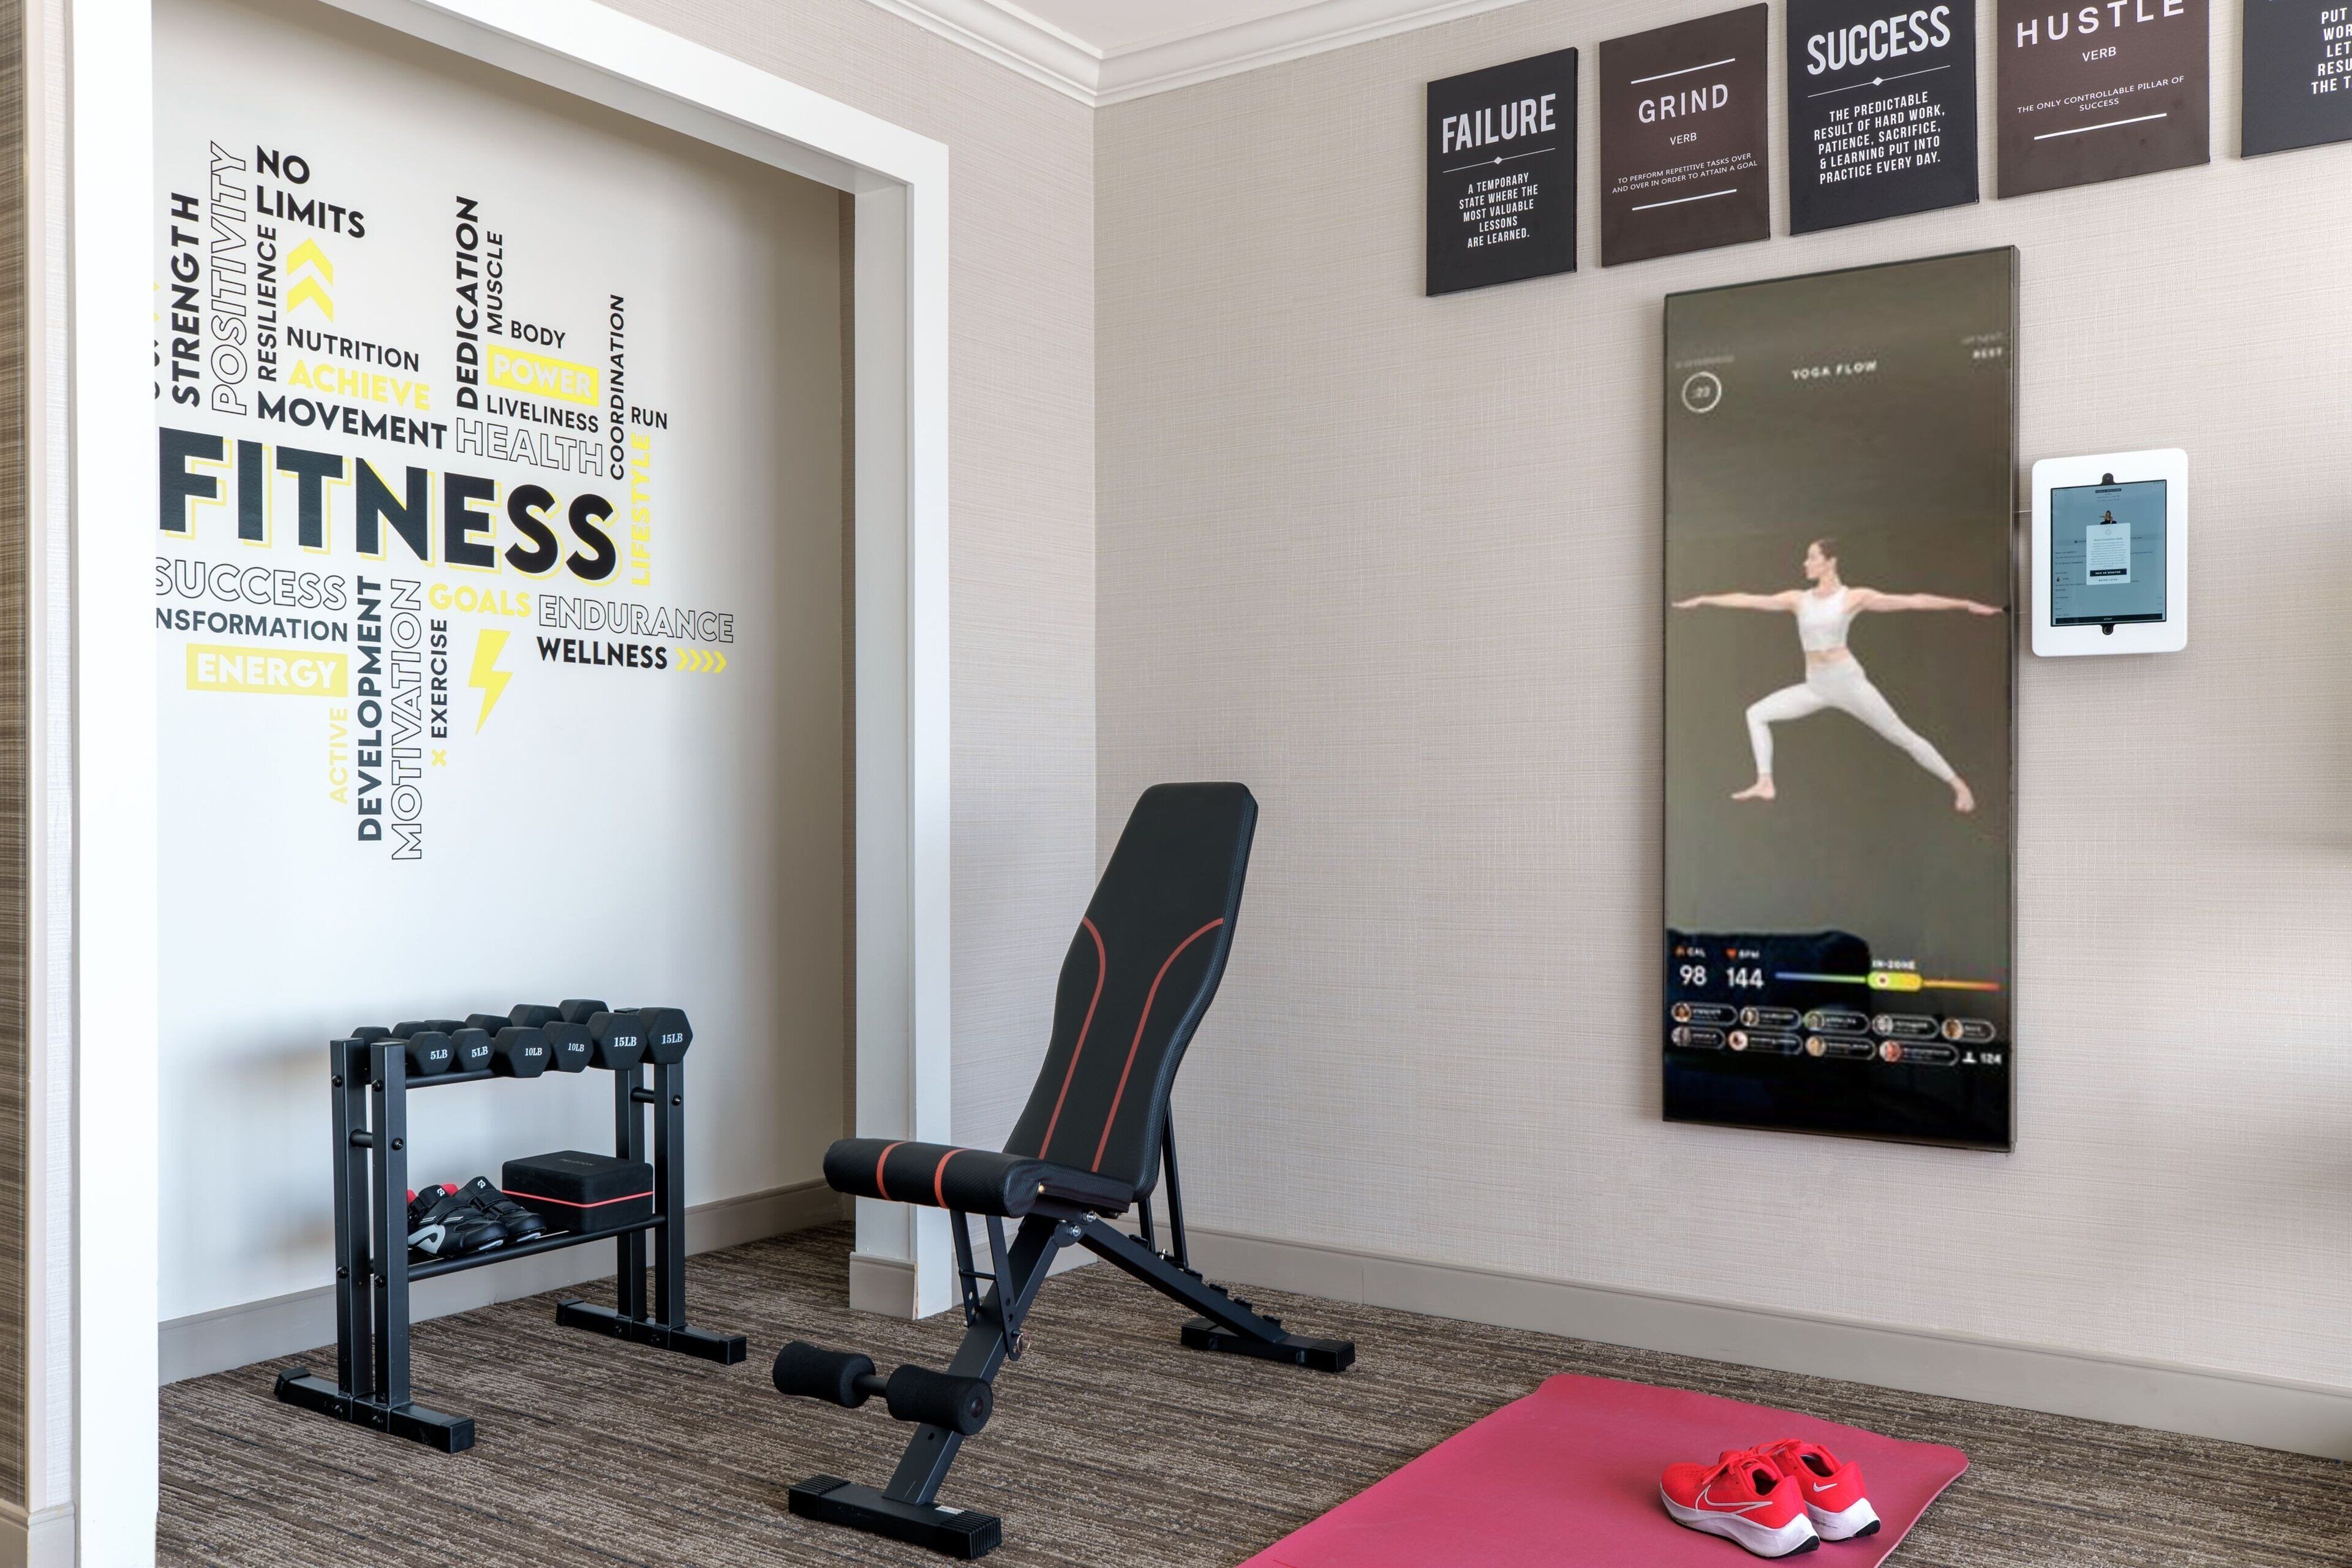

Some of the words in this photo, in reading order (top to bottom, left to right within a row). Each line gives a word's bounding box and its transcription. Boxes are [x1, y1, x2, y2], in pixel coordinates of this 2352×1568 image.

[2017, 0, 2184, 48] HUSTLE
[2321, 7, 2348, 24] PUT
[1807, 6, 1950, 75] SUCCESS
[2082, 47, 2116, 62] VERB
[2326, 40, 2351, 58] LET
[1638, 83, 1728, 123] GRIND
[2017, 104, 2034, 113] THE
[2037, 99, 2062, 110] ONLY
[2064, 85, 2135, 105] CONTROLLABLE
[2138, 78, 2168, 91] PILLAR
[2171, 75, 2184, 85] OF
[2311, 78, 2337, 94] THE
[1830, 108, 1850, 123] THE
[1855, 91, 1929, 119] PREDICTABLE
[2079, 98, 2119, 111] SUCCESS
[1442, 93, 1556, 154] FAILURE
[1670, 132, 1697, 146] VERB
[1814, 123, 1853, 141] RESULT
[1858, 119, 1870, 132] OF
[1875, 112, 1904, 129] HARD
[1909, 104, 1945, 122] WORK,
[1819, 134, 1874, 155] PATIENCE,
[1879, 121, 1941, 143] SACRIFICE,
[257, 145, 310, 184] NO
[1618, 176, 1628, 184] TO
[1630, 170, 1664, 183] PERFORM
[1665, 162, 1705, 176] REPETITIVE
[1706, 157, 1730, 168] TASKS
[1732, 152, 1752, 163] OVER
[1820, 158, 1826, 170] &
[1831, 146, 1885, 168] LEARNING
[1889, 141, 1909, 156] PUT
[1914, 135, 1940, 151] INTO
[1820, 164, 1872, 185] PRACTICE
[1877, 154, 1912, 173] EVERY
[1917, 151, 1941, 166] DAY.
[1468, 184, 1474, 194] A
[1477, 172, 1529, 192] TEMPORARY
[1612, 185, 1628, 194] AND
[1630, 181, 1650, 190] OVER
[1662, 174, 1686, 185] ORDER
[1688, 172, 1698, 180] TO
[1700, 167, 1728, 178] ATTAIN
[1737, 160, 1758, 172] GOAL
[257, 185, 365, 238] LIMITS
[1459, 195, 1485, 210] STATE
[1488, 189, 1518, 203] WHERE
[1521, 184, 1539, 197] THE
[1463, 208, 1487, 222] MOST
[1490, 198, 1534, 217] VALUABLE
[1468, 236, 1484, 248] ARE
[1487, 227, 1529, 245] LEARNED.
[1479, 215, 1518, 233] LESSONS
[211, 140, 247, 416] POSITIVITY
[487, 230, 503, 335] MUSCLE
[171, 192, 200, 408] STRENGTH
[257, 224, 277, 382] RESILIENCE
[456, 195, 478, 410] DEDICATION
[287, 326, 419, 372] NUTRITION
[511, 320, 566, 349] BODY
[288, 359, 430, 410] ACHIEVE
[494, 353, 592, 399] POWER
[610, 294, 624, 480] COORDINATION
[1792, 366, 1830, 380] YOGA
[1836, 360, 1877, 375] FLOW
[258, 391, 447, 450] MOVEMENT
[487, 394, 599, 433] LIVELINESS
[631, 406, 668, 430] RUN
[456, 417, 603, 477] HEALTH
[159, 427, 620, 586] FITNESS
[631, 432, 650, 586] LIFESTYLE
[156, 557, 347, 611] SUCCESS
[428, 583, 531, 617] GOALS
[538, 594, 734, 643] ENDURANCE
[537, 636, 668, 670] WELLNESS
[197, 652, 338, 689] ENERGY
[431, 619, 447, 738] EXERCISE
[357, 575, 382, 842] DEVELOPMENT
[391, 578, 422, 860] MOTIVATION
[329, 707, 348, 805] ACTIVE
[1679, 964, 1707, 987] 98
[1726, 967, 1765, 989] 144
[430, 1049, 448, 1060] 5LB
[471, 1046, 489, 1058] 5LB
[524, 1047, 542, 1057] 10LB
[567, 1042, 585, 1052] 10LB
[614, 1036, 637, 1047] 15LB
[661, 1033, 683, 1044] 15LB
[1980, 1052, 2002, 1064] 124
